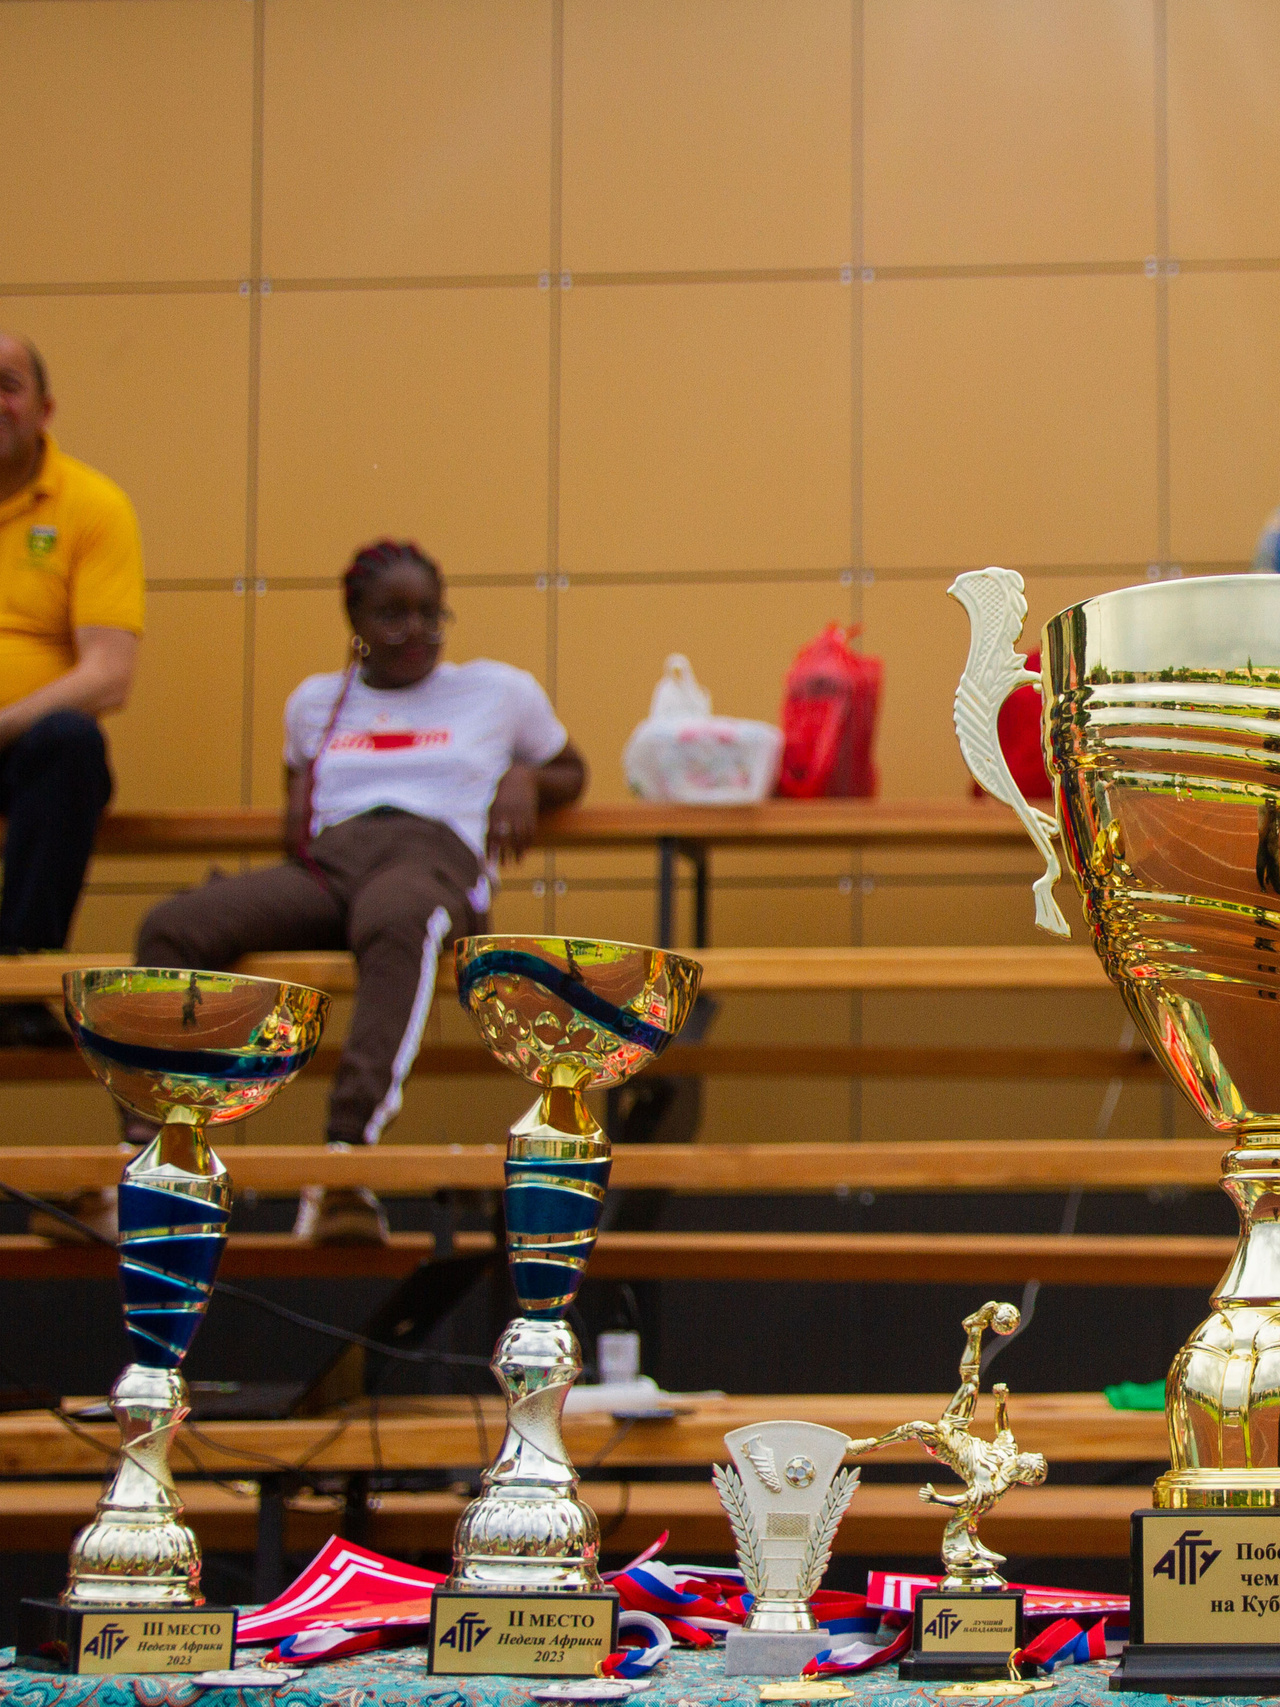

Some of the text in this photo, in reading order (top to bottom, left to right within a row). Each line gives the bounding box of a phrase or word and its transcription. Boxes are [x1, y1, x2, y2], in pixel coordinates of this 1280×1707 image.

[1210, 1600, 1235, 1612] на
[530, 1614, 595, 1628] МЕСТО
[167, 1624, 221, 1636] МЕСТО
[498, 1633, 602, 1650] Неделя Африки
[137, 1642, 223, 1654] Неделя Африки
[167, 1656, 192, 1665] 2023
[534, 1651, 564, 1662] 2023
